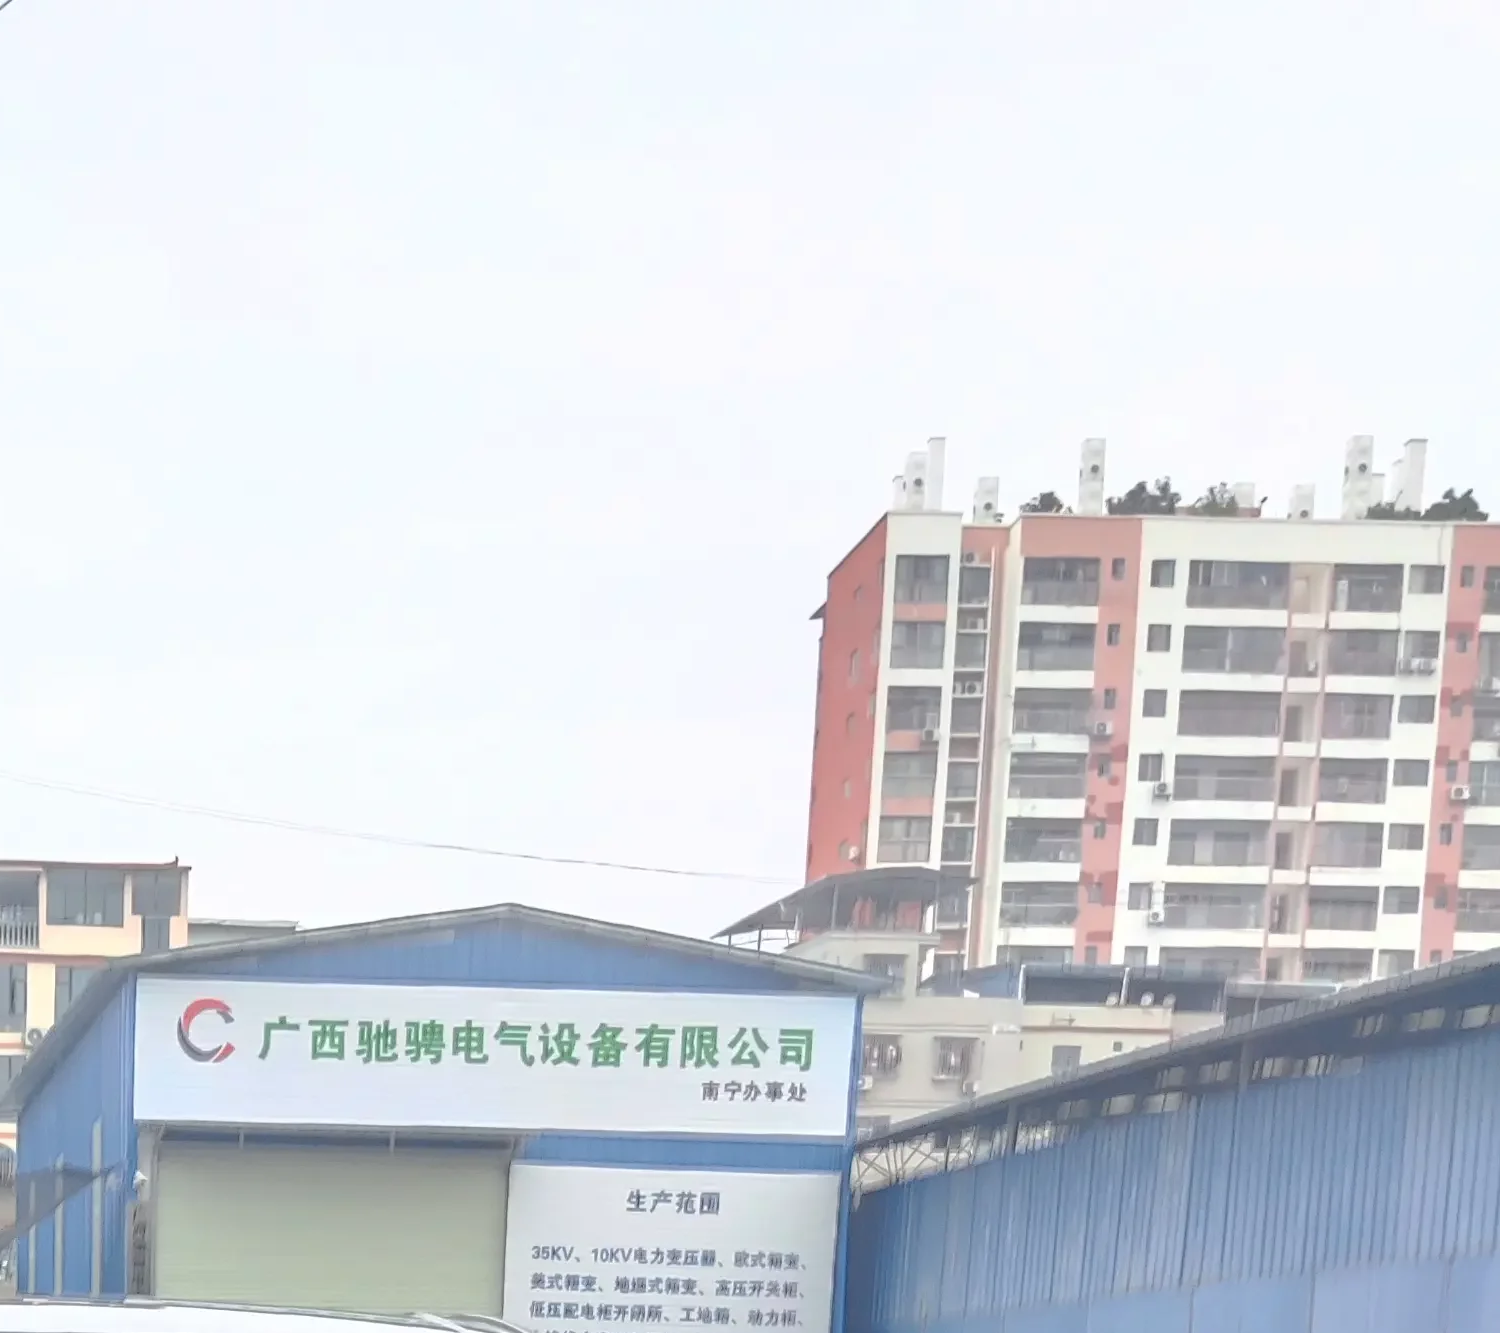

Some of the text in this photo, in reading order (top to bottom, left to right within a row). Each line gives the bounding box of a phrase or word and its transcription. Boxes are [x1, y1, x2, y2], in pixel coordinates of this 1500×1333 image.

[701, 1080, 807, 1102] 南宁办事处
[626, 1189, 721, 1215] 生产范围
